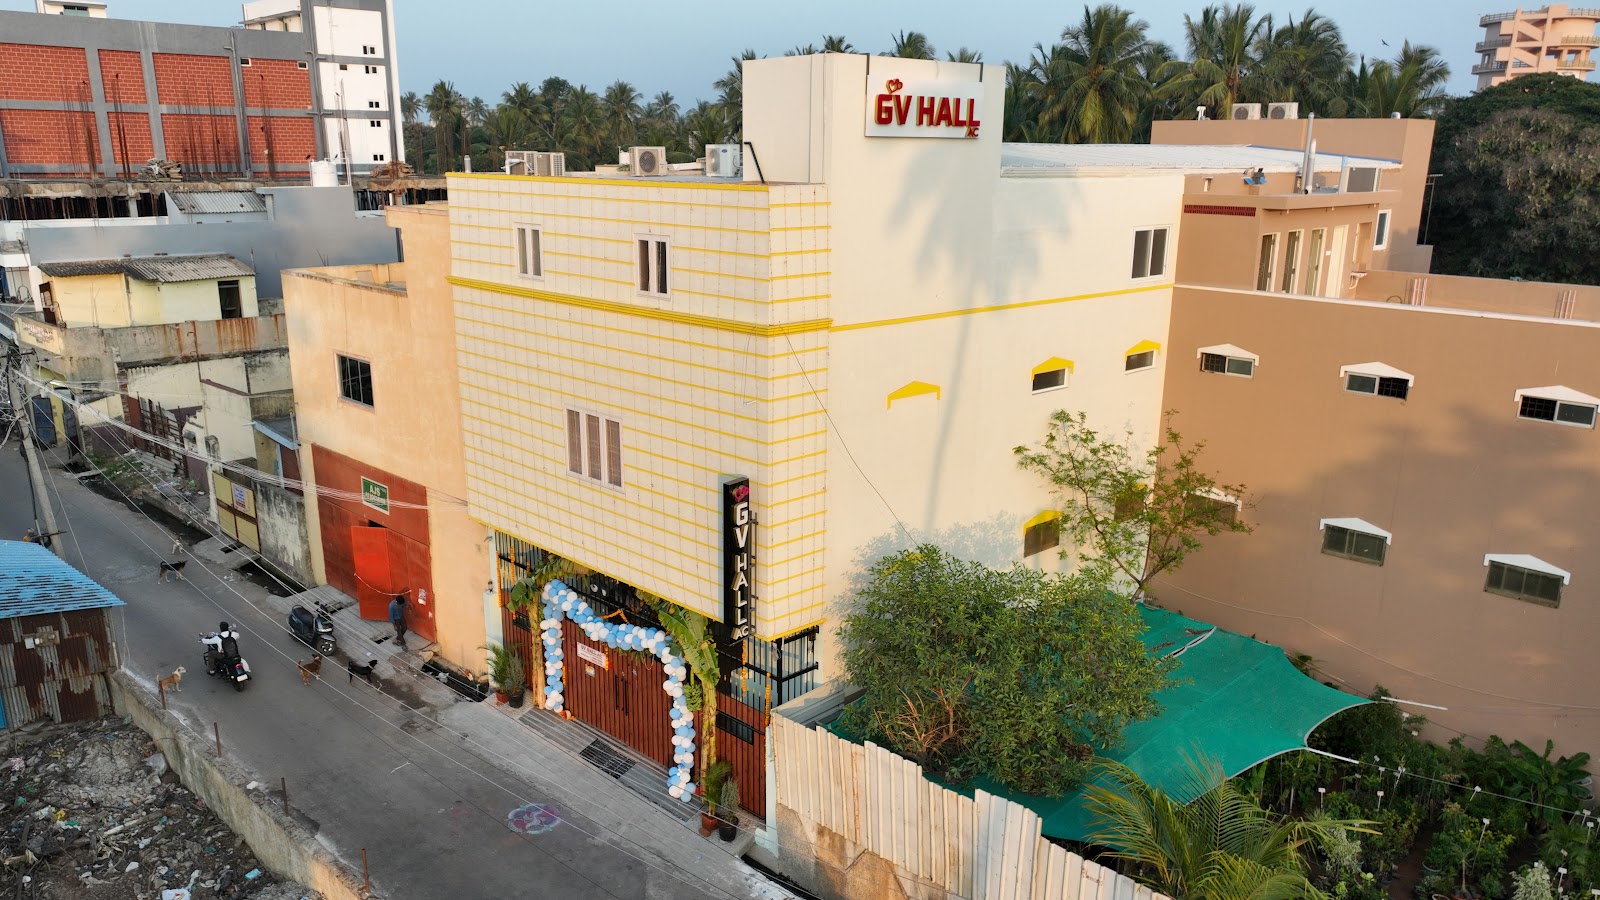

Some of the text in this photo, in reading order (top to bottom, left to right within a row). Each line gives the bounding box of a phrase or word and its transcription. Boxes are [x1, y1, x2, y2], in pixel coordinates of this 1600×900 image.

[875, 94, 980, 126] GV HALL
[966, 127, 979, 137] AC
[732, 501, 749, 625] GV HALL
[732, 625, 749, 640] AC
